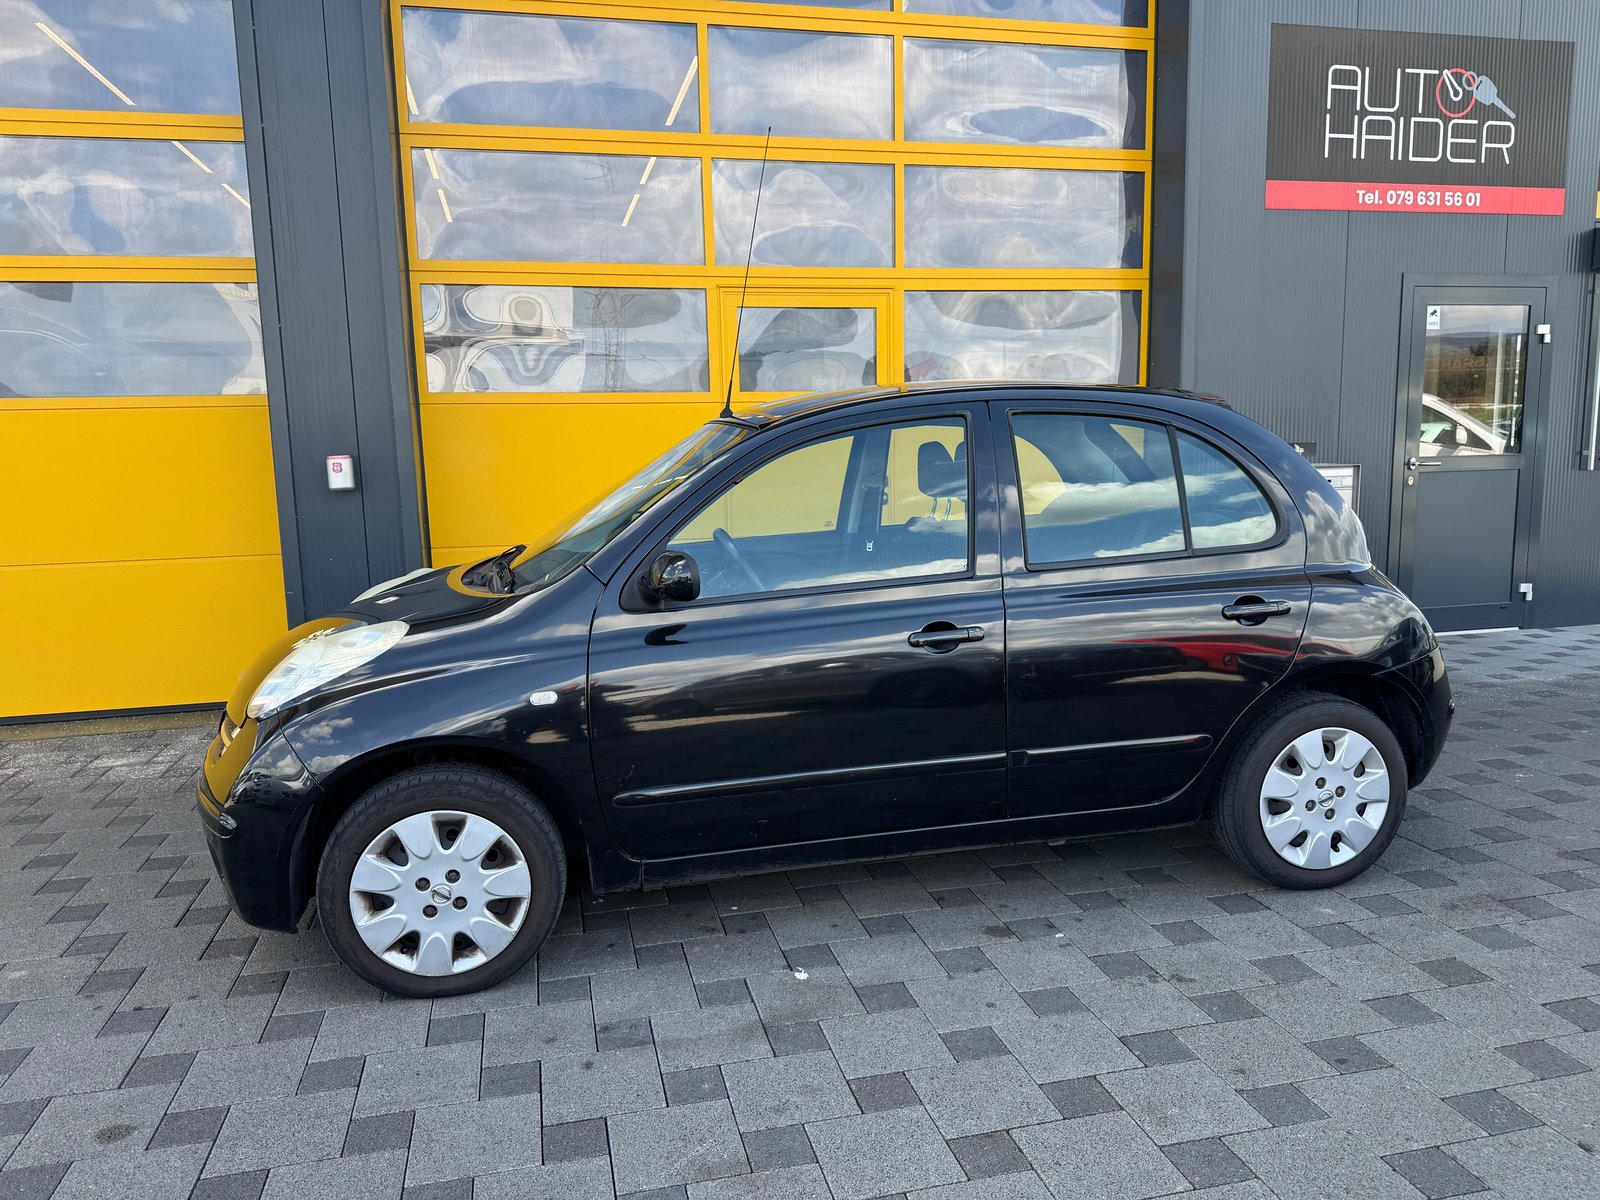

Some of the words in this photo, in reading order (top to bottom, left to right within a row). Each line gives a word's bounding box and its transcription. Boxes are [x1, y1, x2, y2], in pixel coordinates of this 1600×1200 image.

[1326, 64, 1477, 118] AUTO
[1324, 113, 1516, 165] HAIDER
[1356, 189, 1384, 205] Tel.
[1386, 190, 1414, 206] 079
[1416, 190, 1441, 206] 631
[1444, 191, 1463, 207] 56
[1465, 191, 1481, 207] 01
